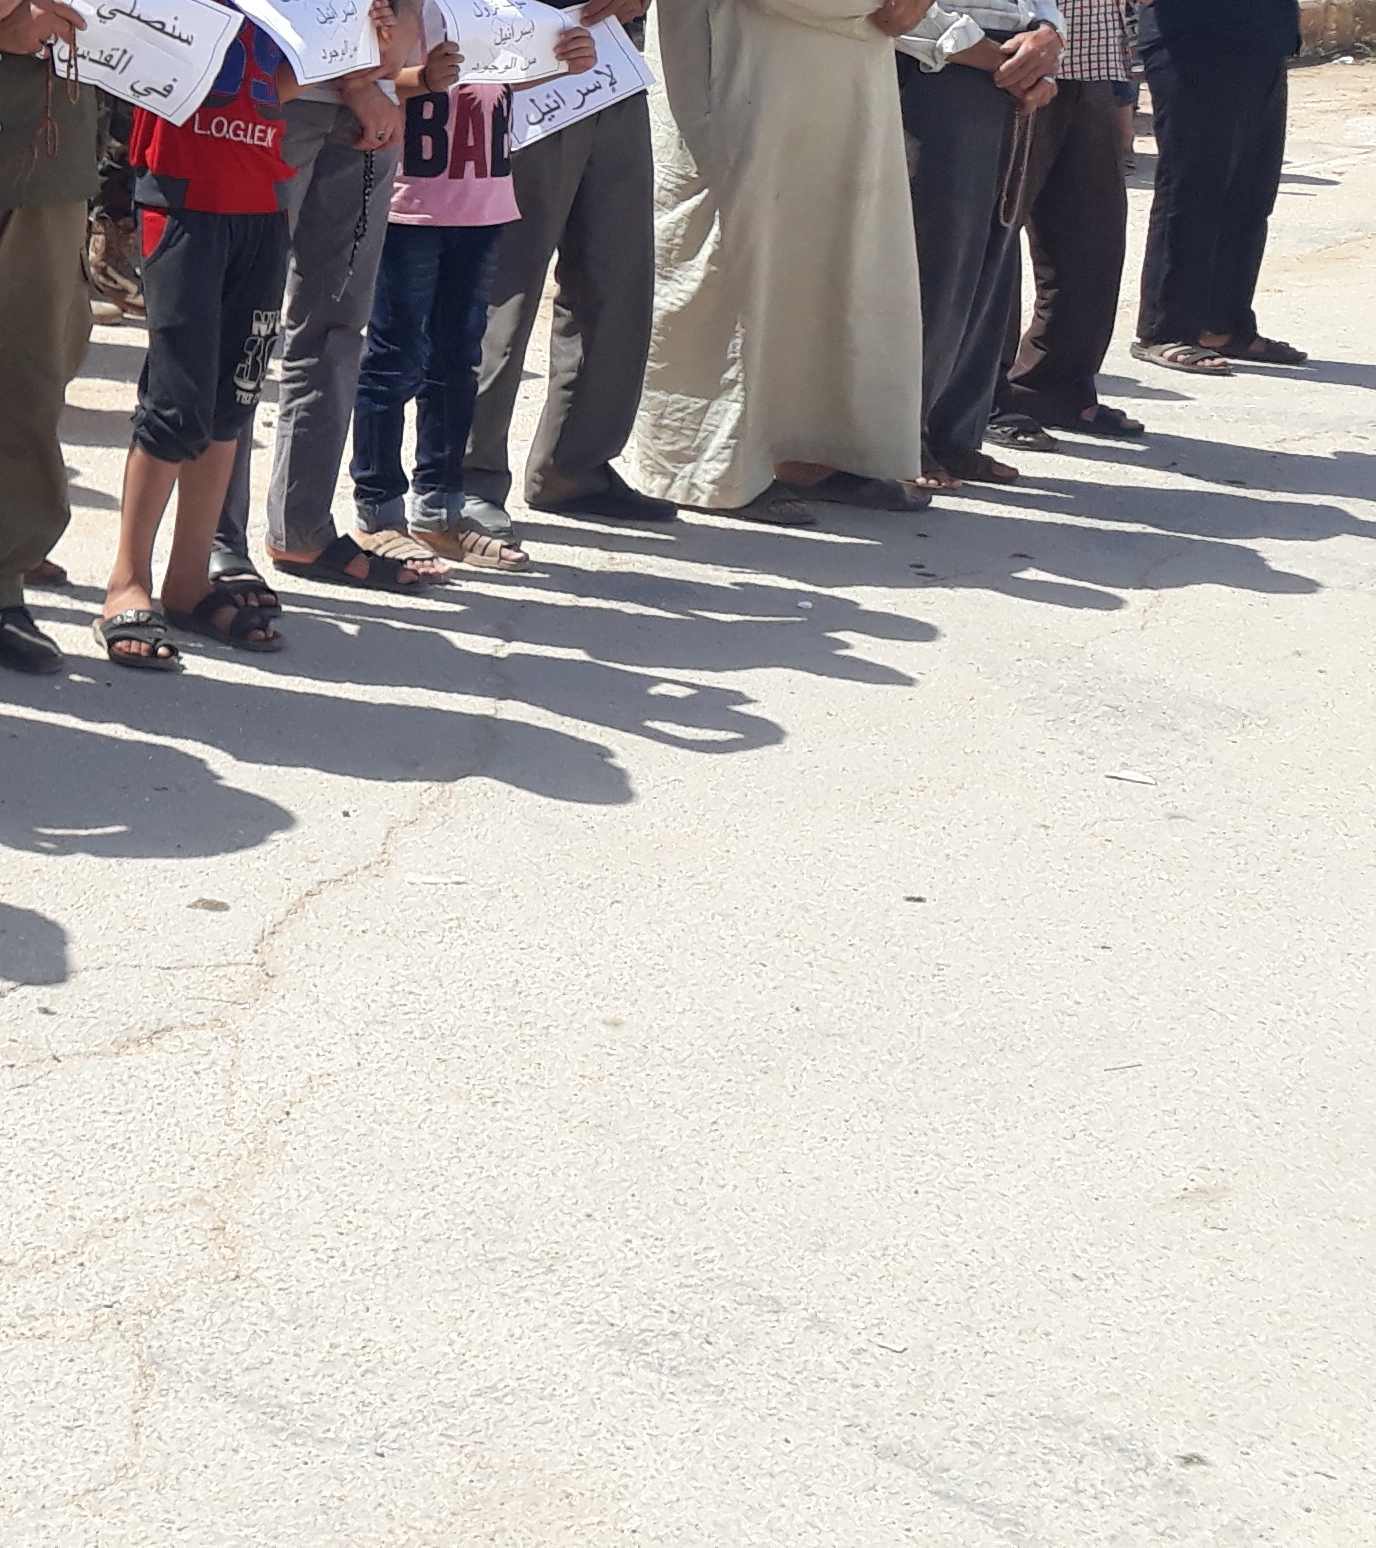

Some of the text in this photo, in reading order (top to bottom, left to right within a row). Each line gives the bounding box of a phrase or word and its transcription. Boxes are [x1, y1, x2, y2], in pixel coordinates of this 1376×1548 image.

[57, 47, 178, 99] في القدس
[520, 56, 537, 72] من
[525, 64, 618, 126] لإسرائيل
